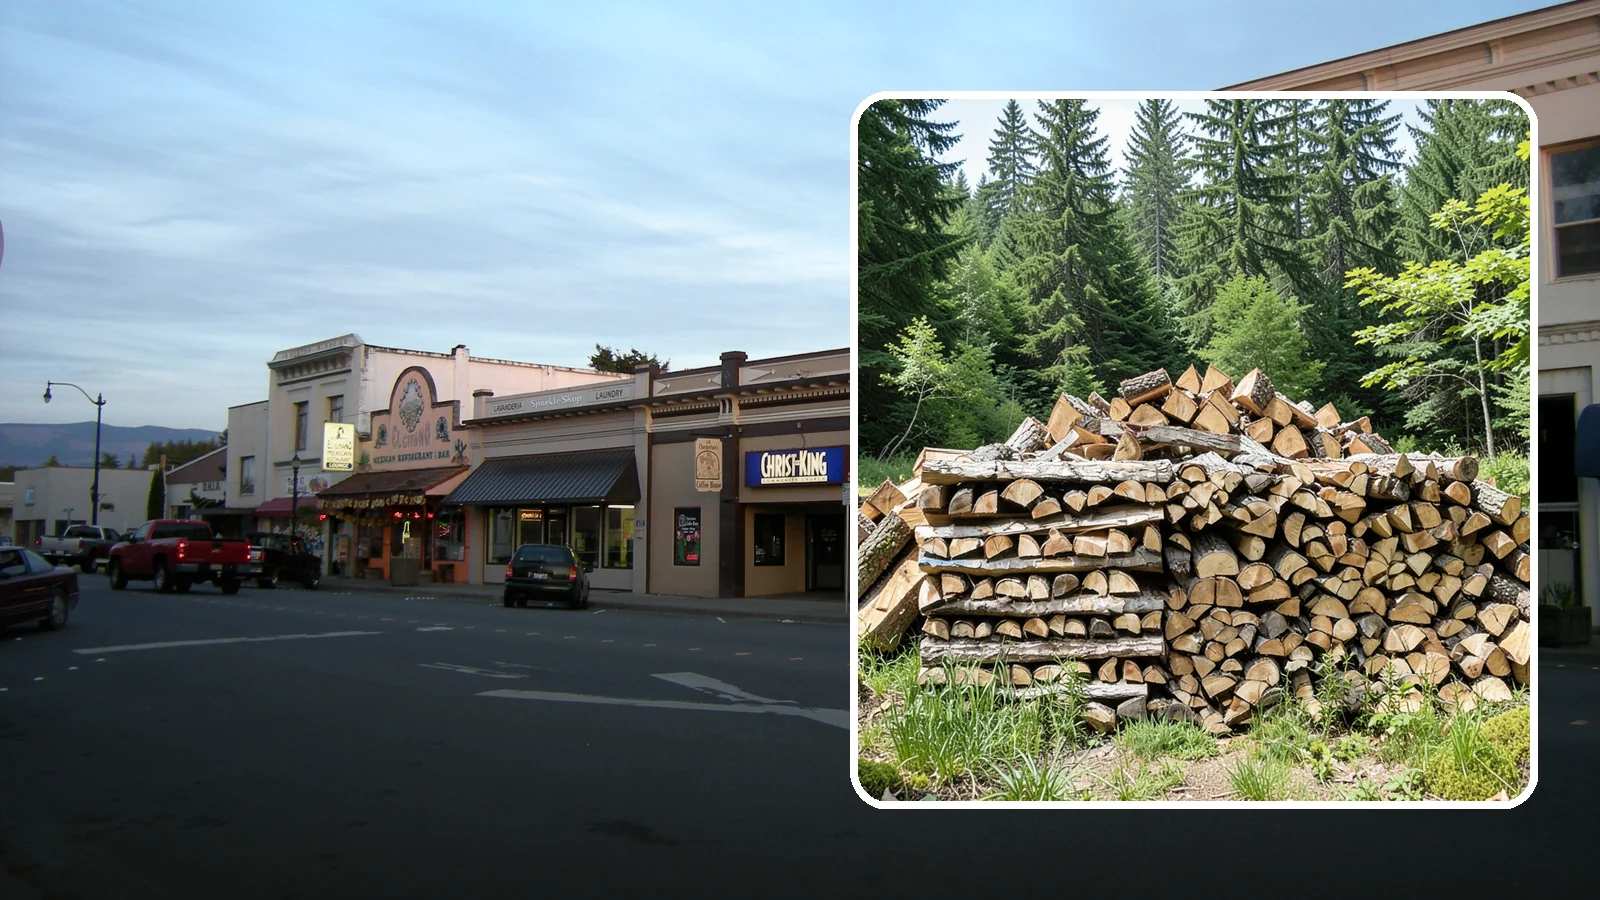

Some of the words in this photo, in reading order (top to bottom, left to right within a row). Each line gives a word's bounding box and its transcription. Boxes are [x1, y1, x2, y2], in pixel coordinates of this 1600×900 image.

[595, 388, 623, 399] LAUNDRY
[561, 394, 582, 406] Shop
[493, 402, 522, 412] LAVANDERIA
[397, 451, 433, 462] RESTAURANT
[437, 450, 450, 458] BAR
[761, 452, 797, 478] CHRIST
[799, 450, 828, 476] KING
